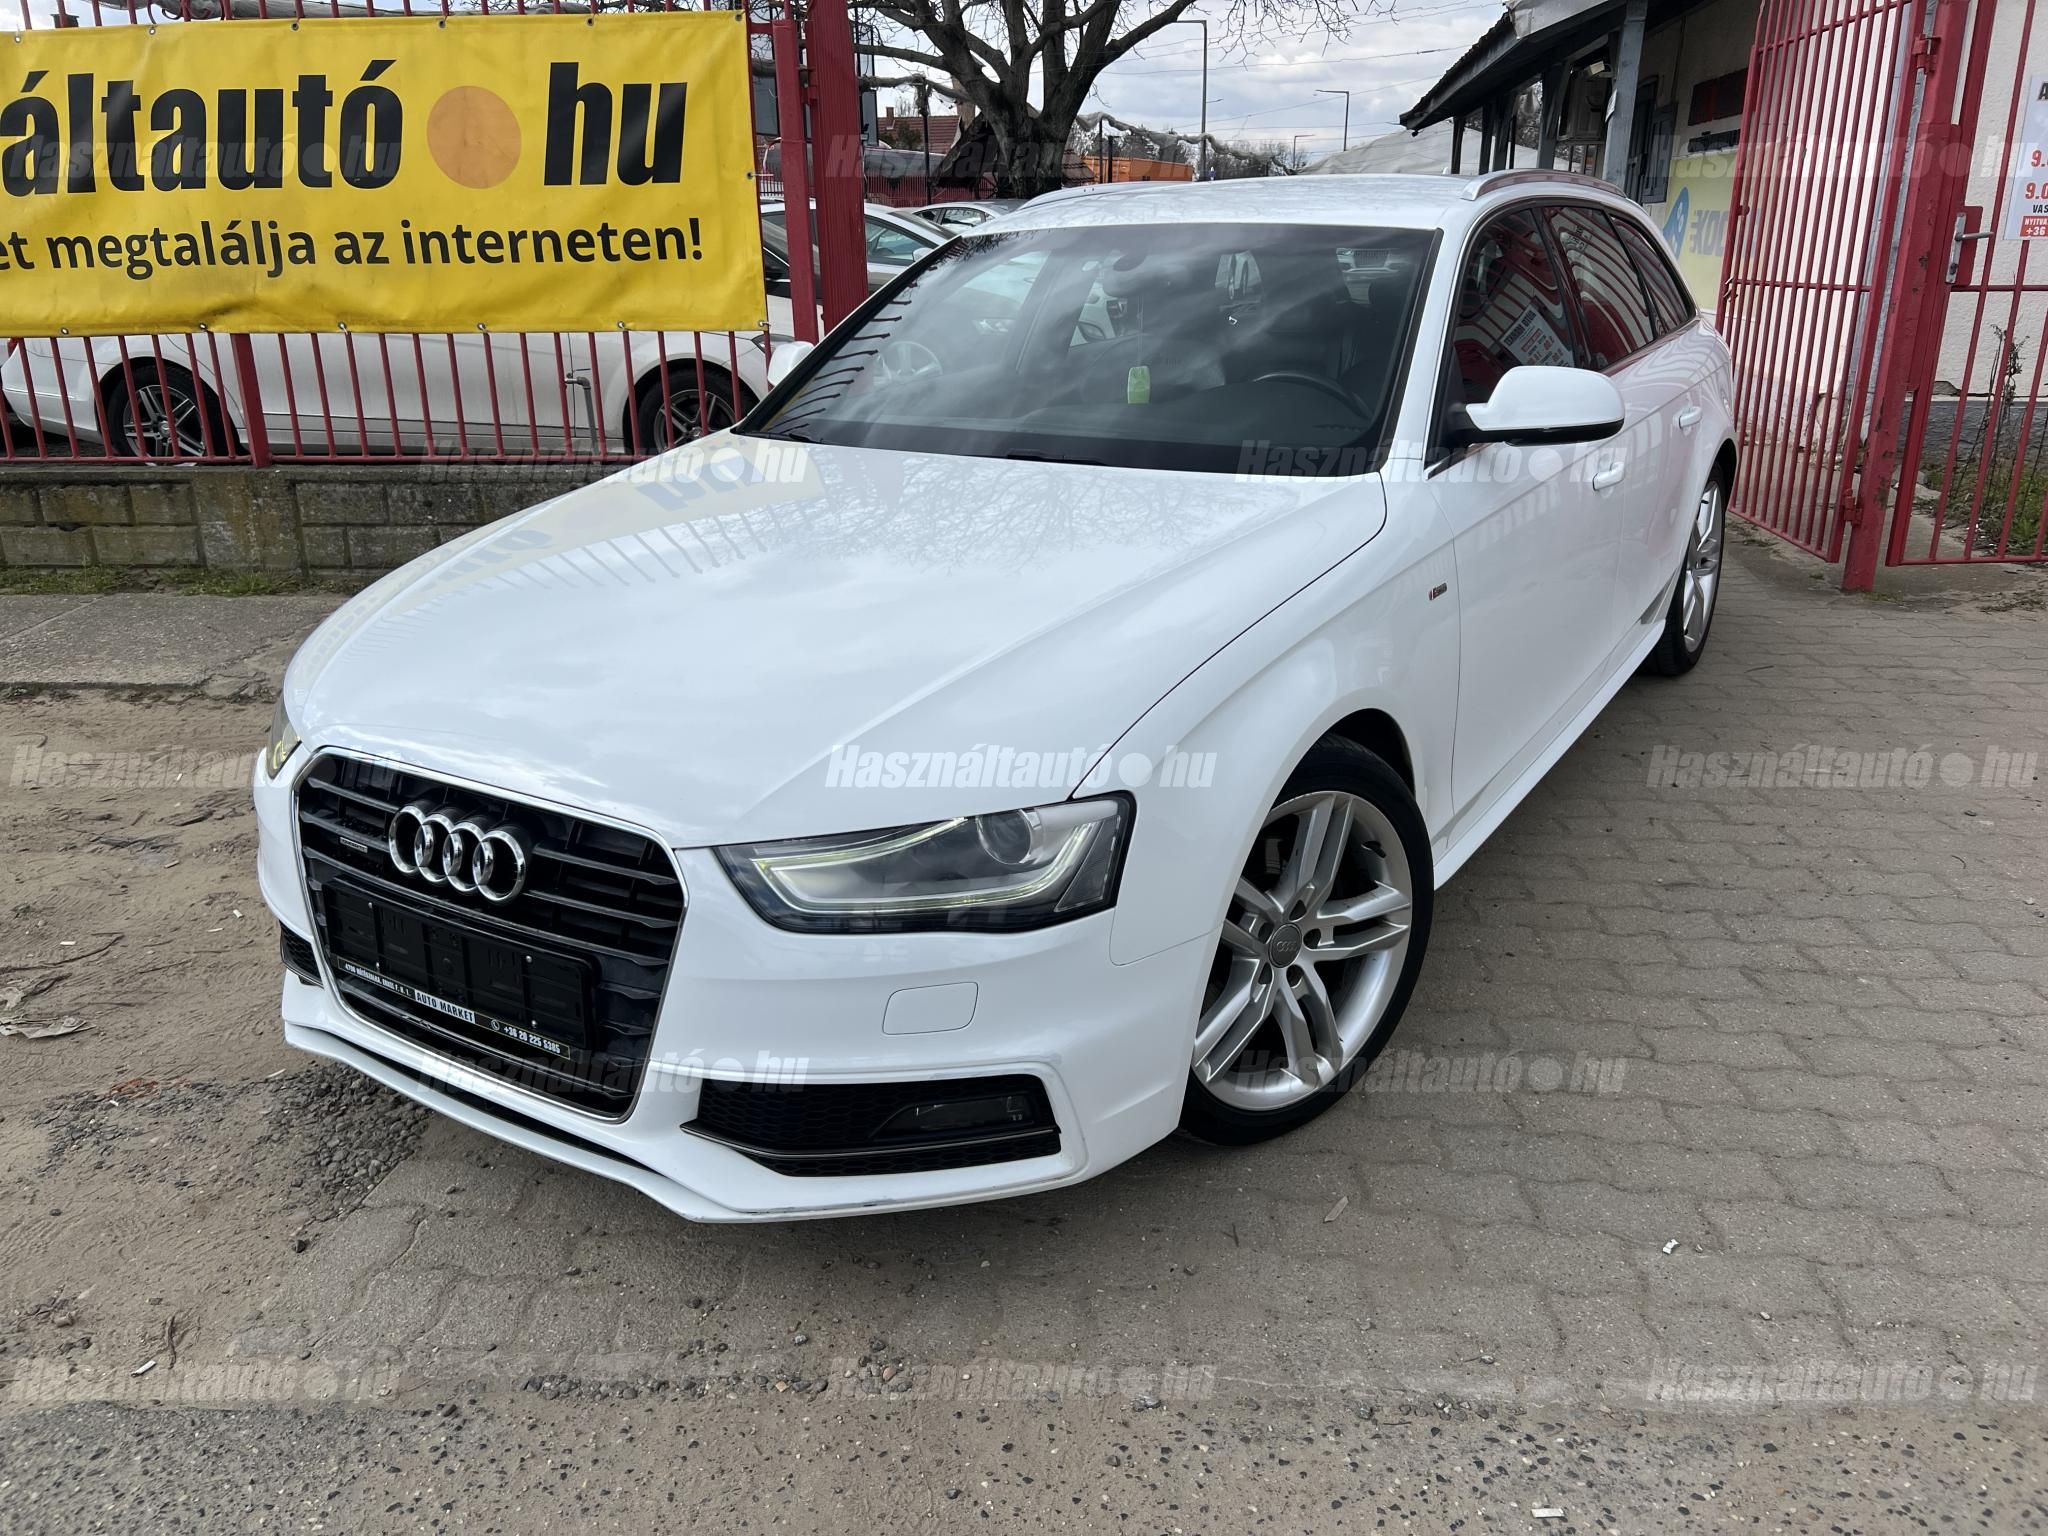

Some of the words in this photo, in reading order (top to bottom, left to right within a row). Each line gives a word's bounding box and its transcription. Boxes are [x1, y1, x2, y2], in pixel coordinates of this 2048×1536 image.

[0, 60, 403, 197] áltautó
[543, 62, 689, 187] hu
[46, 220, 316, 280] megtalálja
[334, 231, 388, 264] az
[401, 218, 702, 264] interneten!
[2026, 226, 2046, 236] +36
[416, 992, 437, 1008] AUTO
[440, 1002, 473, 1021] MARKET
